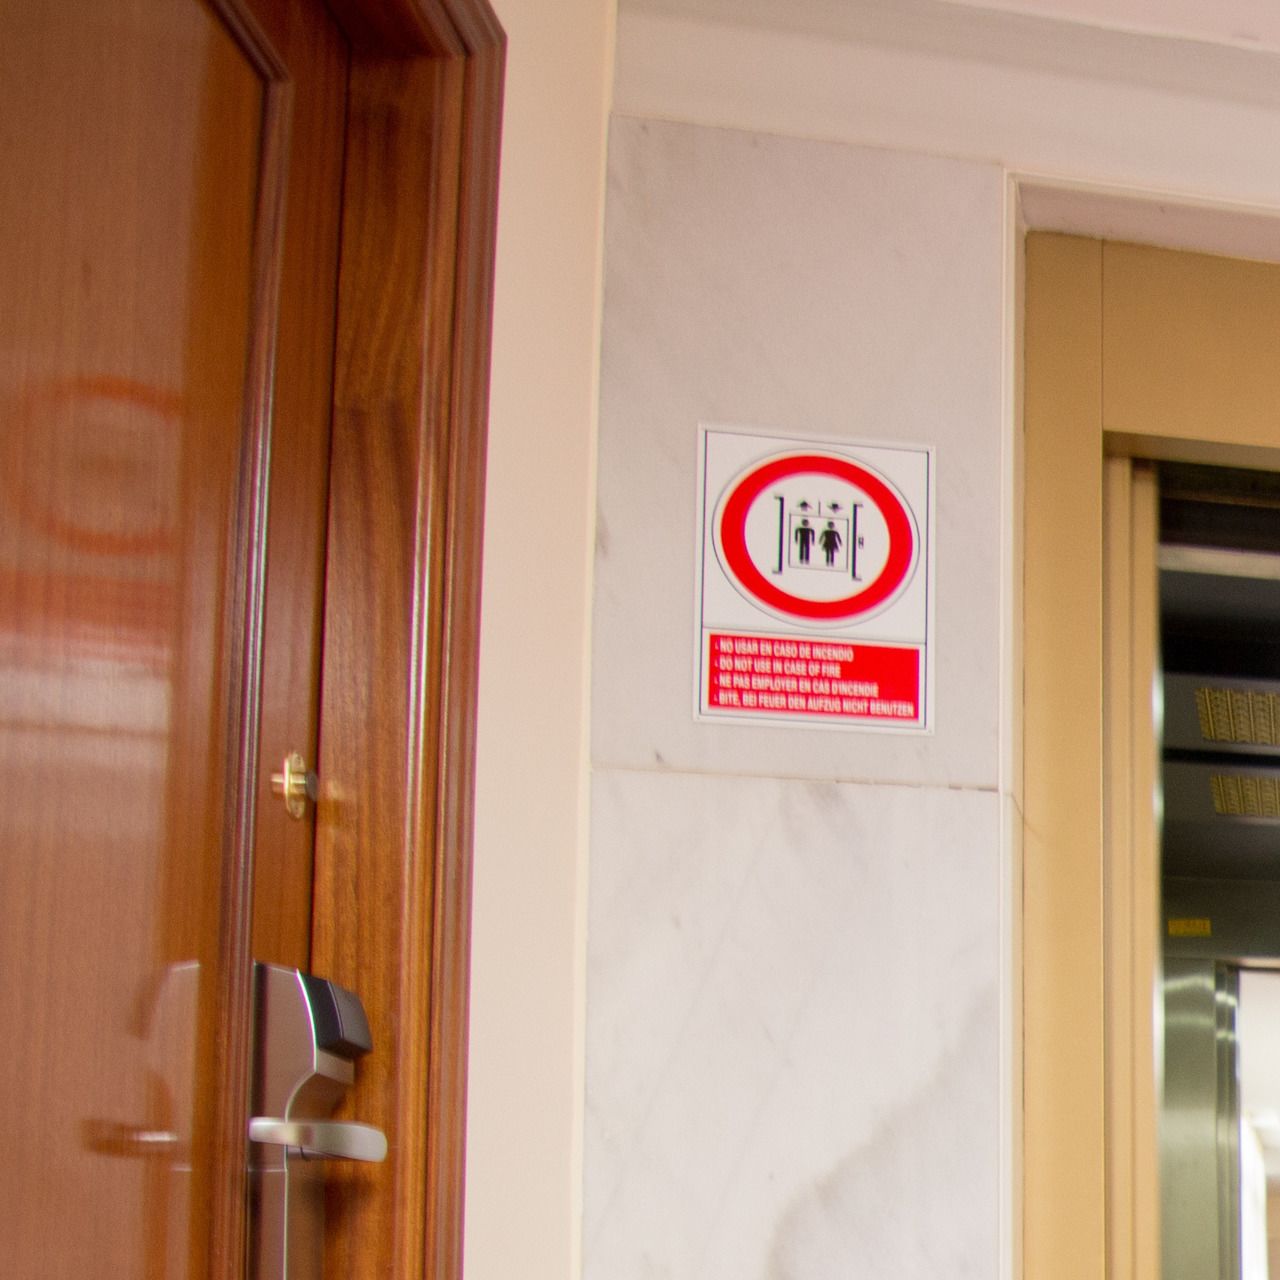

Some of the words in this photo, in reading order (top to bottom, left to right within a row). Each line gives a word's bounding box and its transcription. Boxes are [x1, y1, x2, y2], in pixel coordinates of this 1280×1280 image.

[720, 638, 734, 653] NO
[735, 639, 758, 655] USAR
[760, 641, 772, 656] EN
[774, 642, 798, 658] CASO
[799, 643, 812, 659] DE
[813, 645, 854, 662] INCENDIO
[719, 655, 733, 670] DO
[735, 656, 752, 672] NOT
[754, 657, 771, 673] USE
[773, 659, 782, 674] IN
[784, 660, 806, 676] CASE
[808, 662, 821, 677] OF
[822, 663, 841, 678] FIRE
[719, 672, 732, 687] NE
[733, 673, 750, 689] PAS
[752, 674, 797, 692] EMPLOYER
[799, 678, 811, 693] EN
[813, 679, 830, 694] CAS
[831, 681, 879, 697] D'INCENDIE
[742, 690, 757, 706] BEI
[759, 691, 786, 708] FEUER
[788, 695, 806, 710] DEN
[807, 696, 841, 712] AUFZUG
[842, 698, 869, 714] NICHT
[870, 699, 914, 717] BENUTZEN
